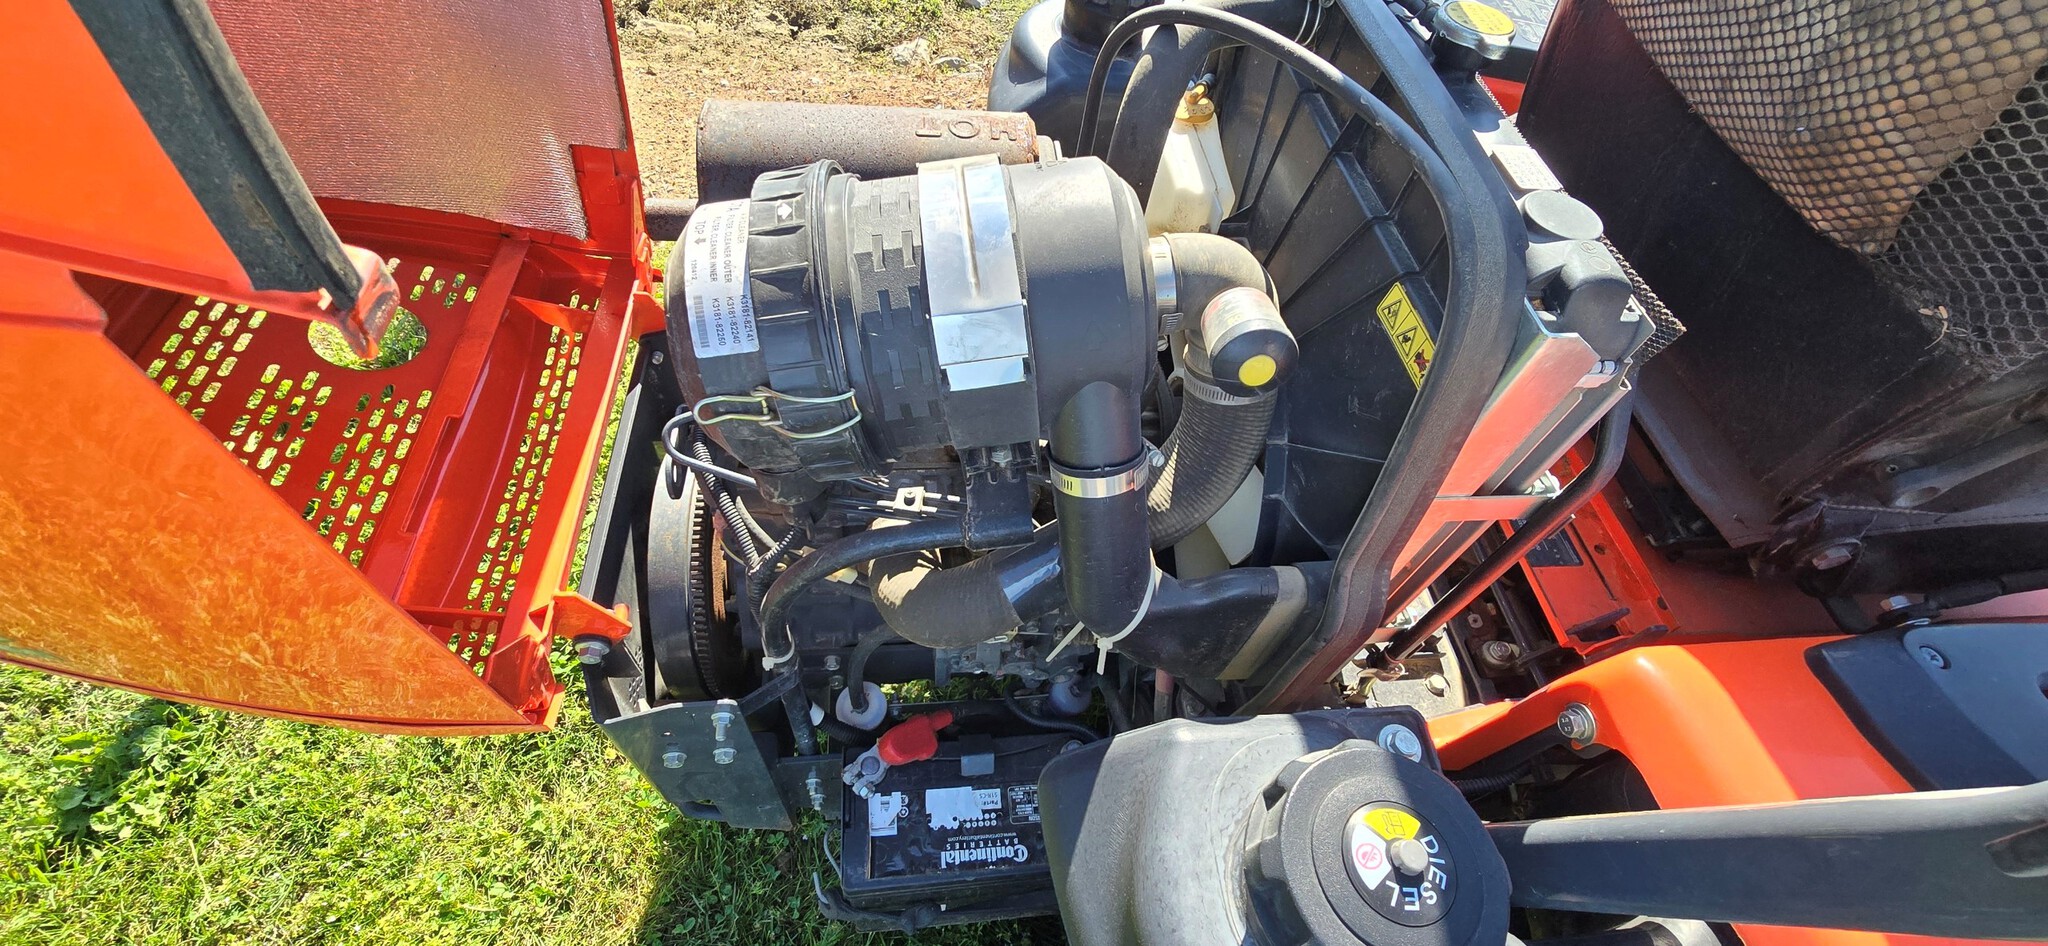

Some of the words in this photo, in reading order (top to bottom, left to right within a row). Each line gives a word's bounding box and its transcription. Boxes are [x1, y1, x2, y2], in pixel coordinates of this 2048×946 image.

[914, 114, 1017, 141] HOT
[694, 220, 706, 235] TOP
[709, 261, 718, 283] INNER
[723, 259, 732, 284] OUTER
[945, 837, 1019, 850] BATTERIES
[947, 832, 1017, 842] www.continentalbattery.com
[941, 844, 1028, 869] Continental
[1386, 835, 1447, 911] DIESEL
